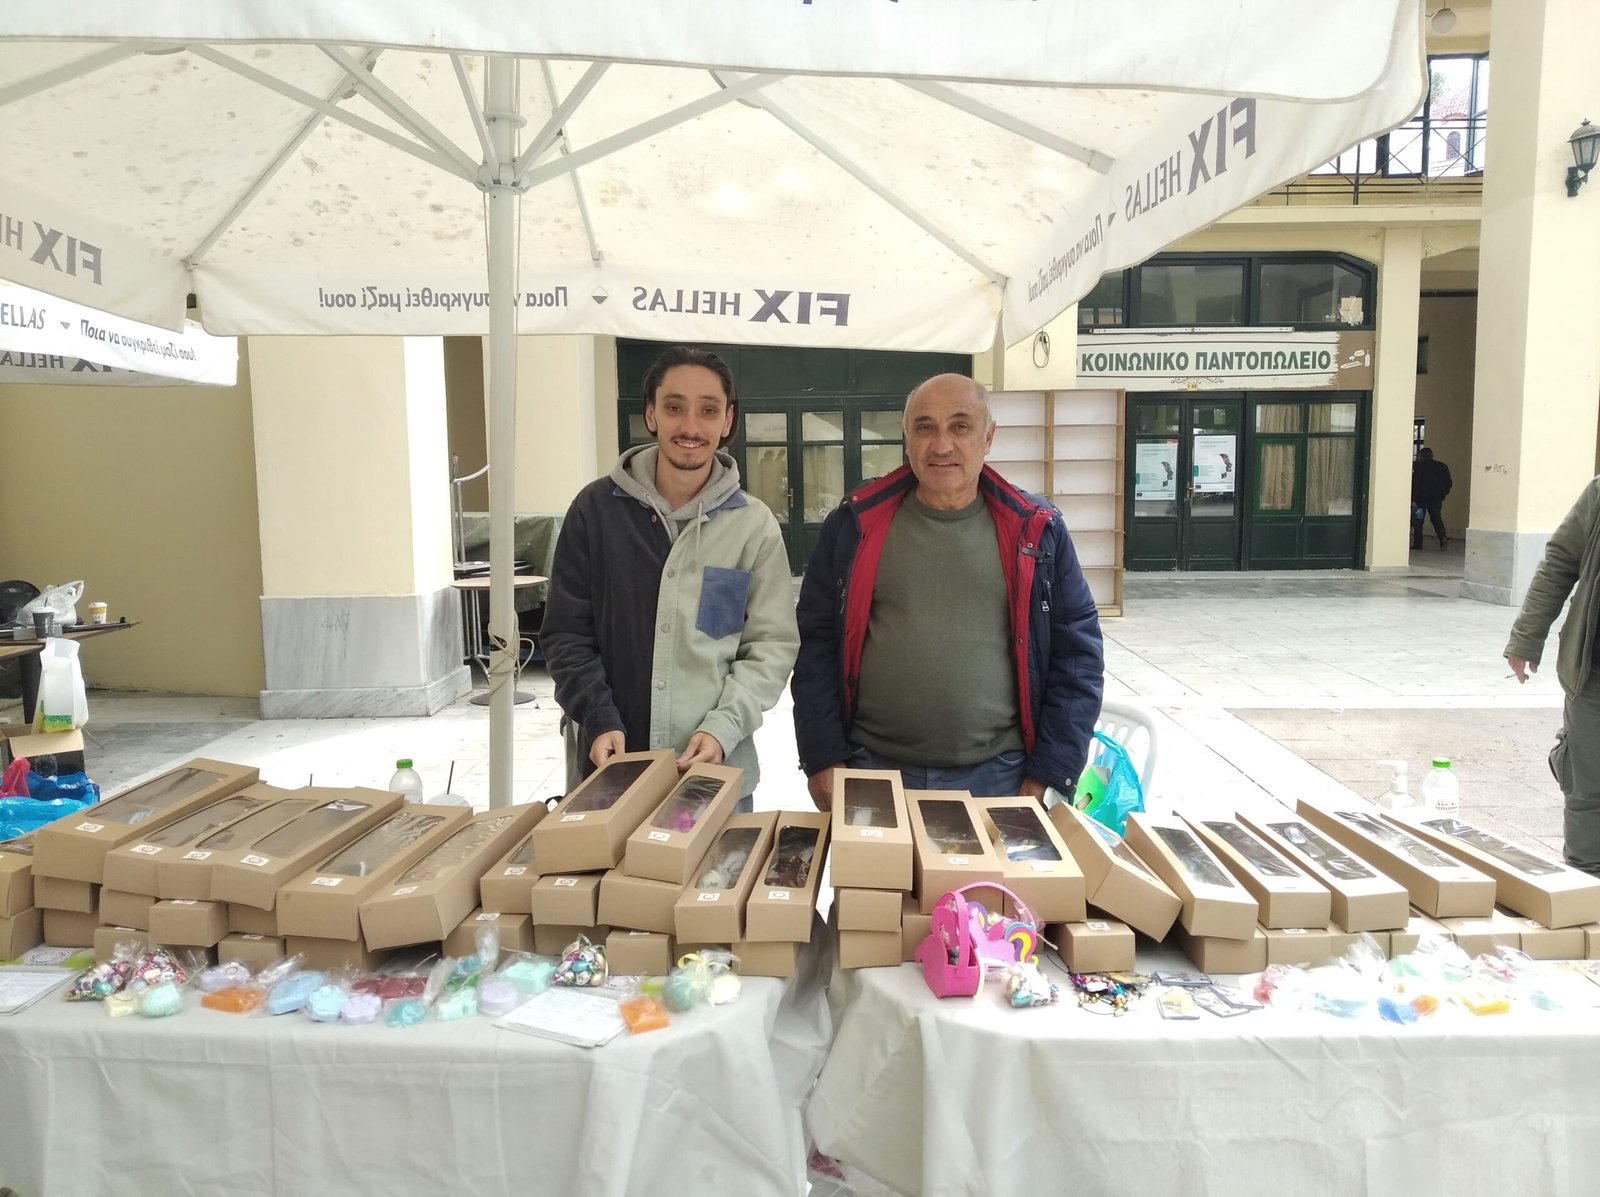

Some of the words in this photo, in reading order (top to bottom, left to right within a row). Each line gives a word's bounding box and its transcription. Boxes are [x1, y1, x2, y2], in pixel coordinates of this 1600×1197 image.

[80, 318, 106, 342] Ποια
[108, 331, 120, 345] να
[1081, 352, 1189, 372] ΚΟΙΝΩΝΙΚΟ
[1195, 350, 1332, 371] ΠΑΝΤΟΠΩΛΕΙΟ
